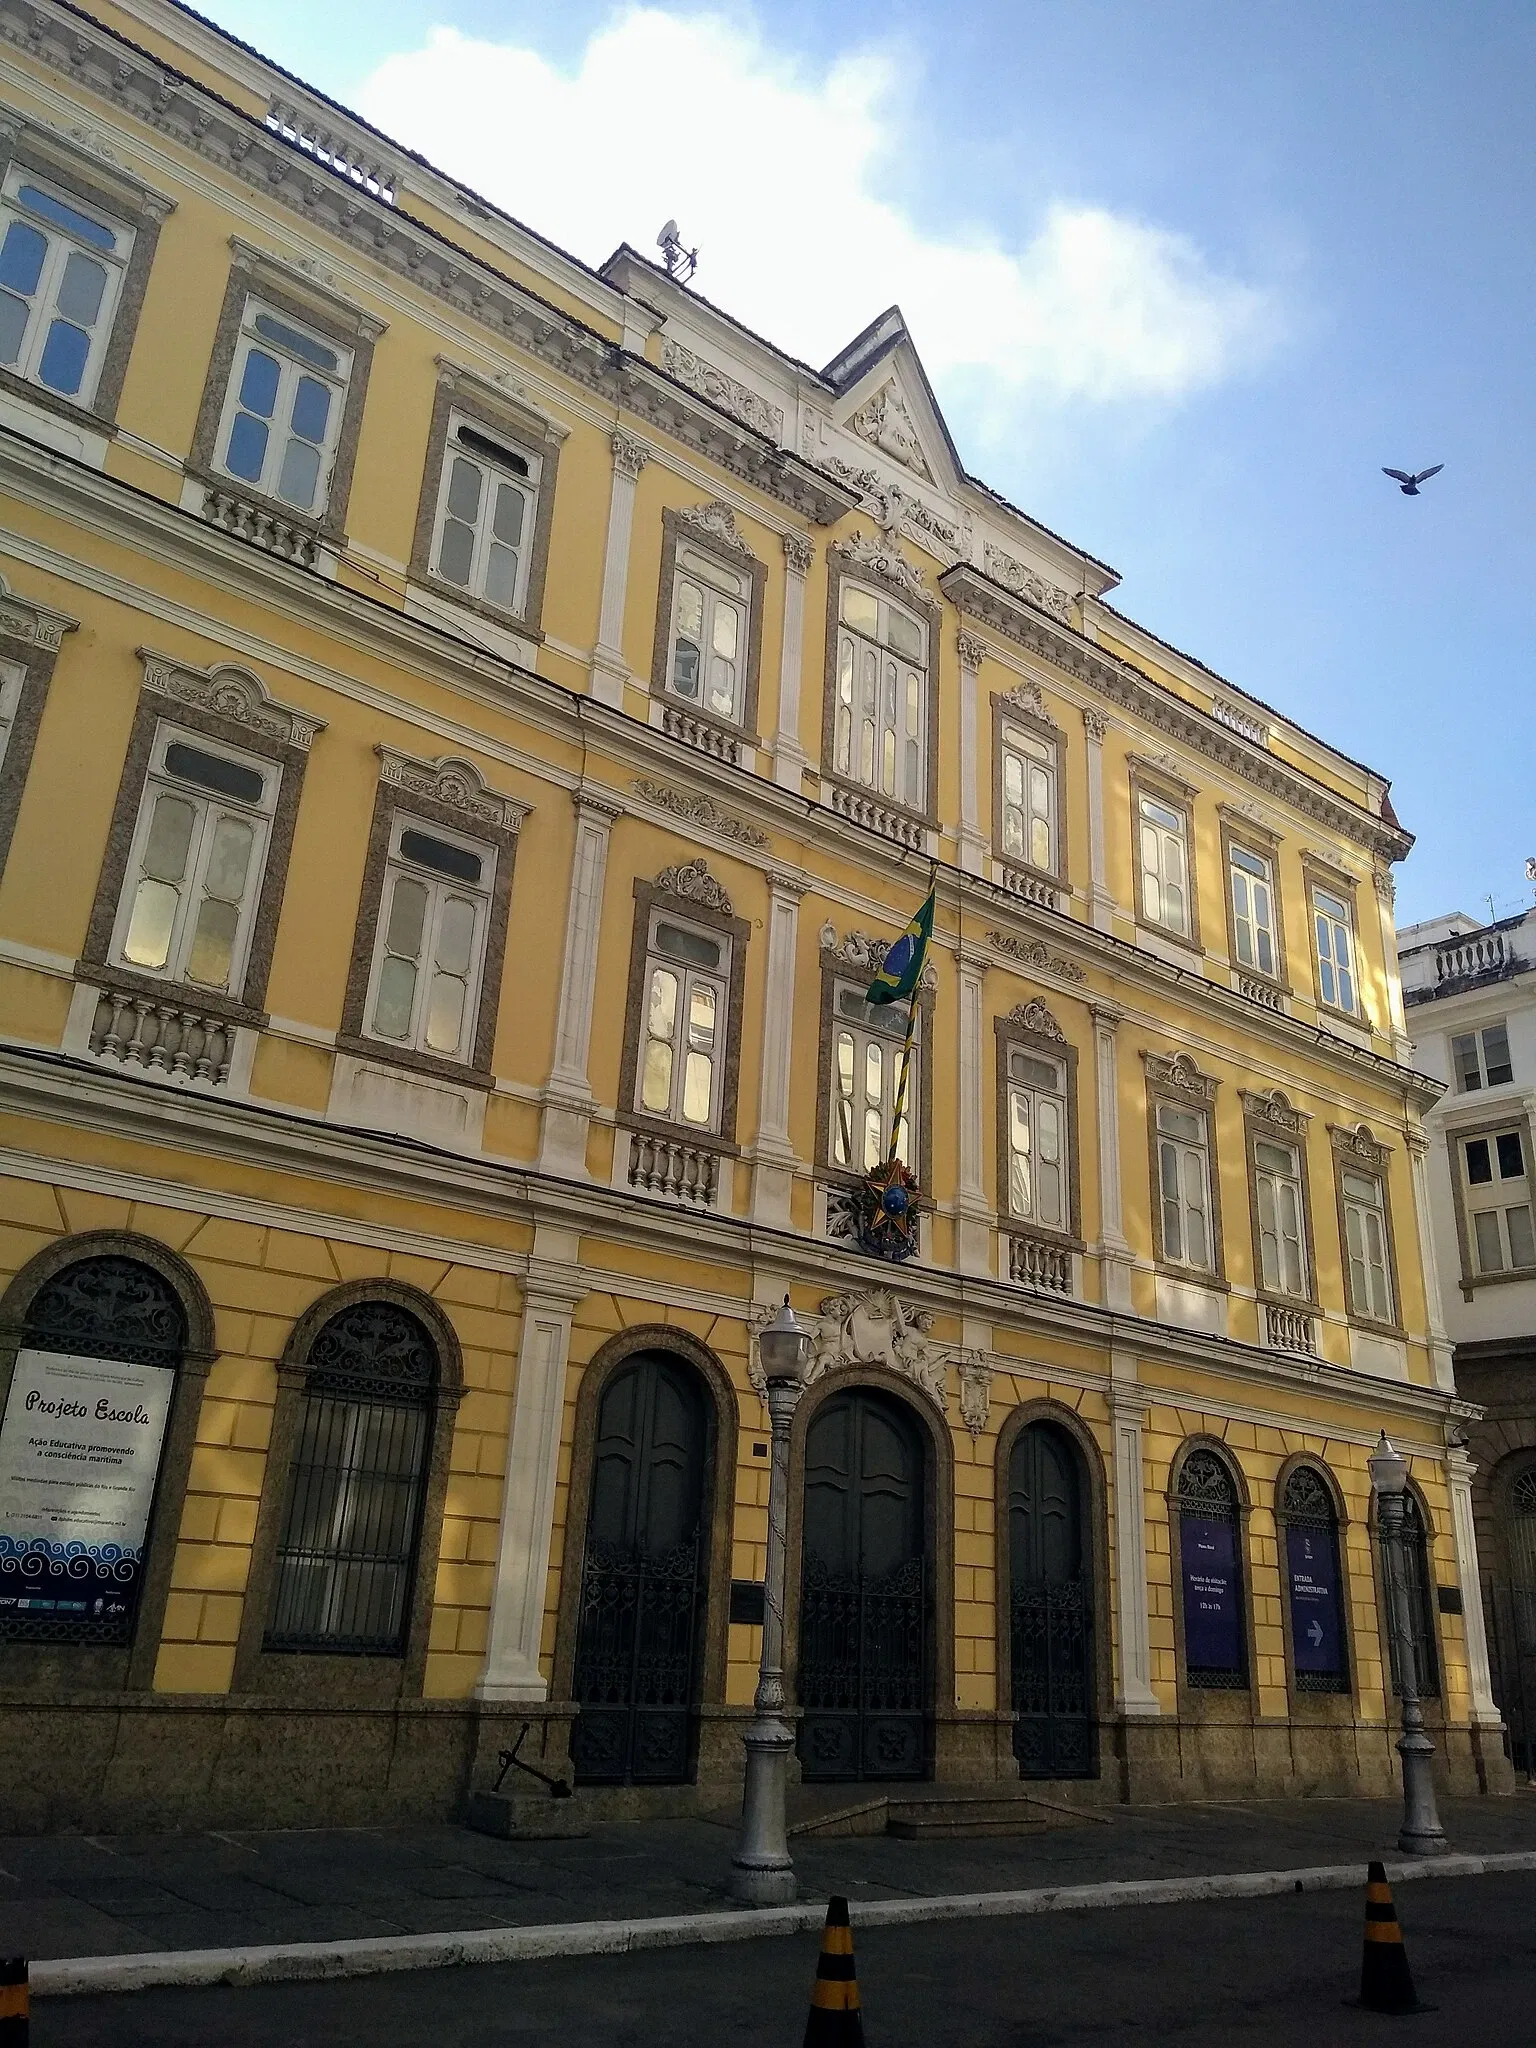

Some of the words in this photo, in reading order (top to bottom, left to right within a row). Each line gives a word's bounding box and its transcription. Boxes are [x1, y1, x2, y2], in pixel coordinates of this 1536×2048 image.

[25, 1390, 87, 1419] Projeto
[95, 1399, 150, 1425] Escola
[29, 1438, 48, 1448] Ação
[50, 1440, 86, 1450] Educativa
[88, 1445, 135, 1456] promovendo
[45, 1451, 87, 1461] consciência
[89, 1455, 123, 1465] marítima
[1294, 1574, 1313, 1583] ENTRADA
[1208, 1586, 1224, 1594] domingo
[1295, 1585, 1328, 1595] ADMINISTRATIVA
